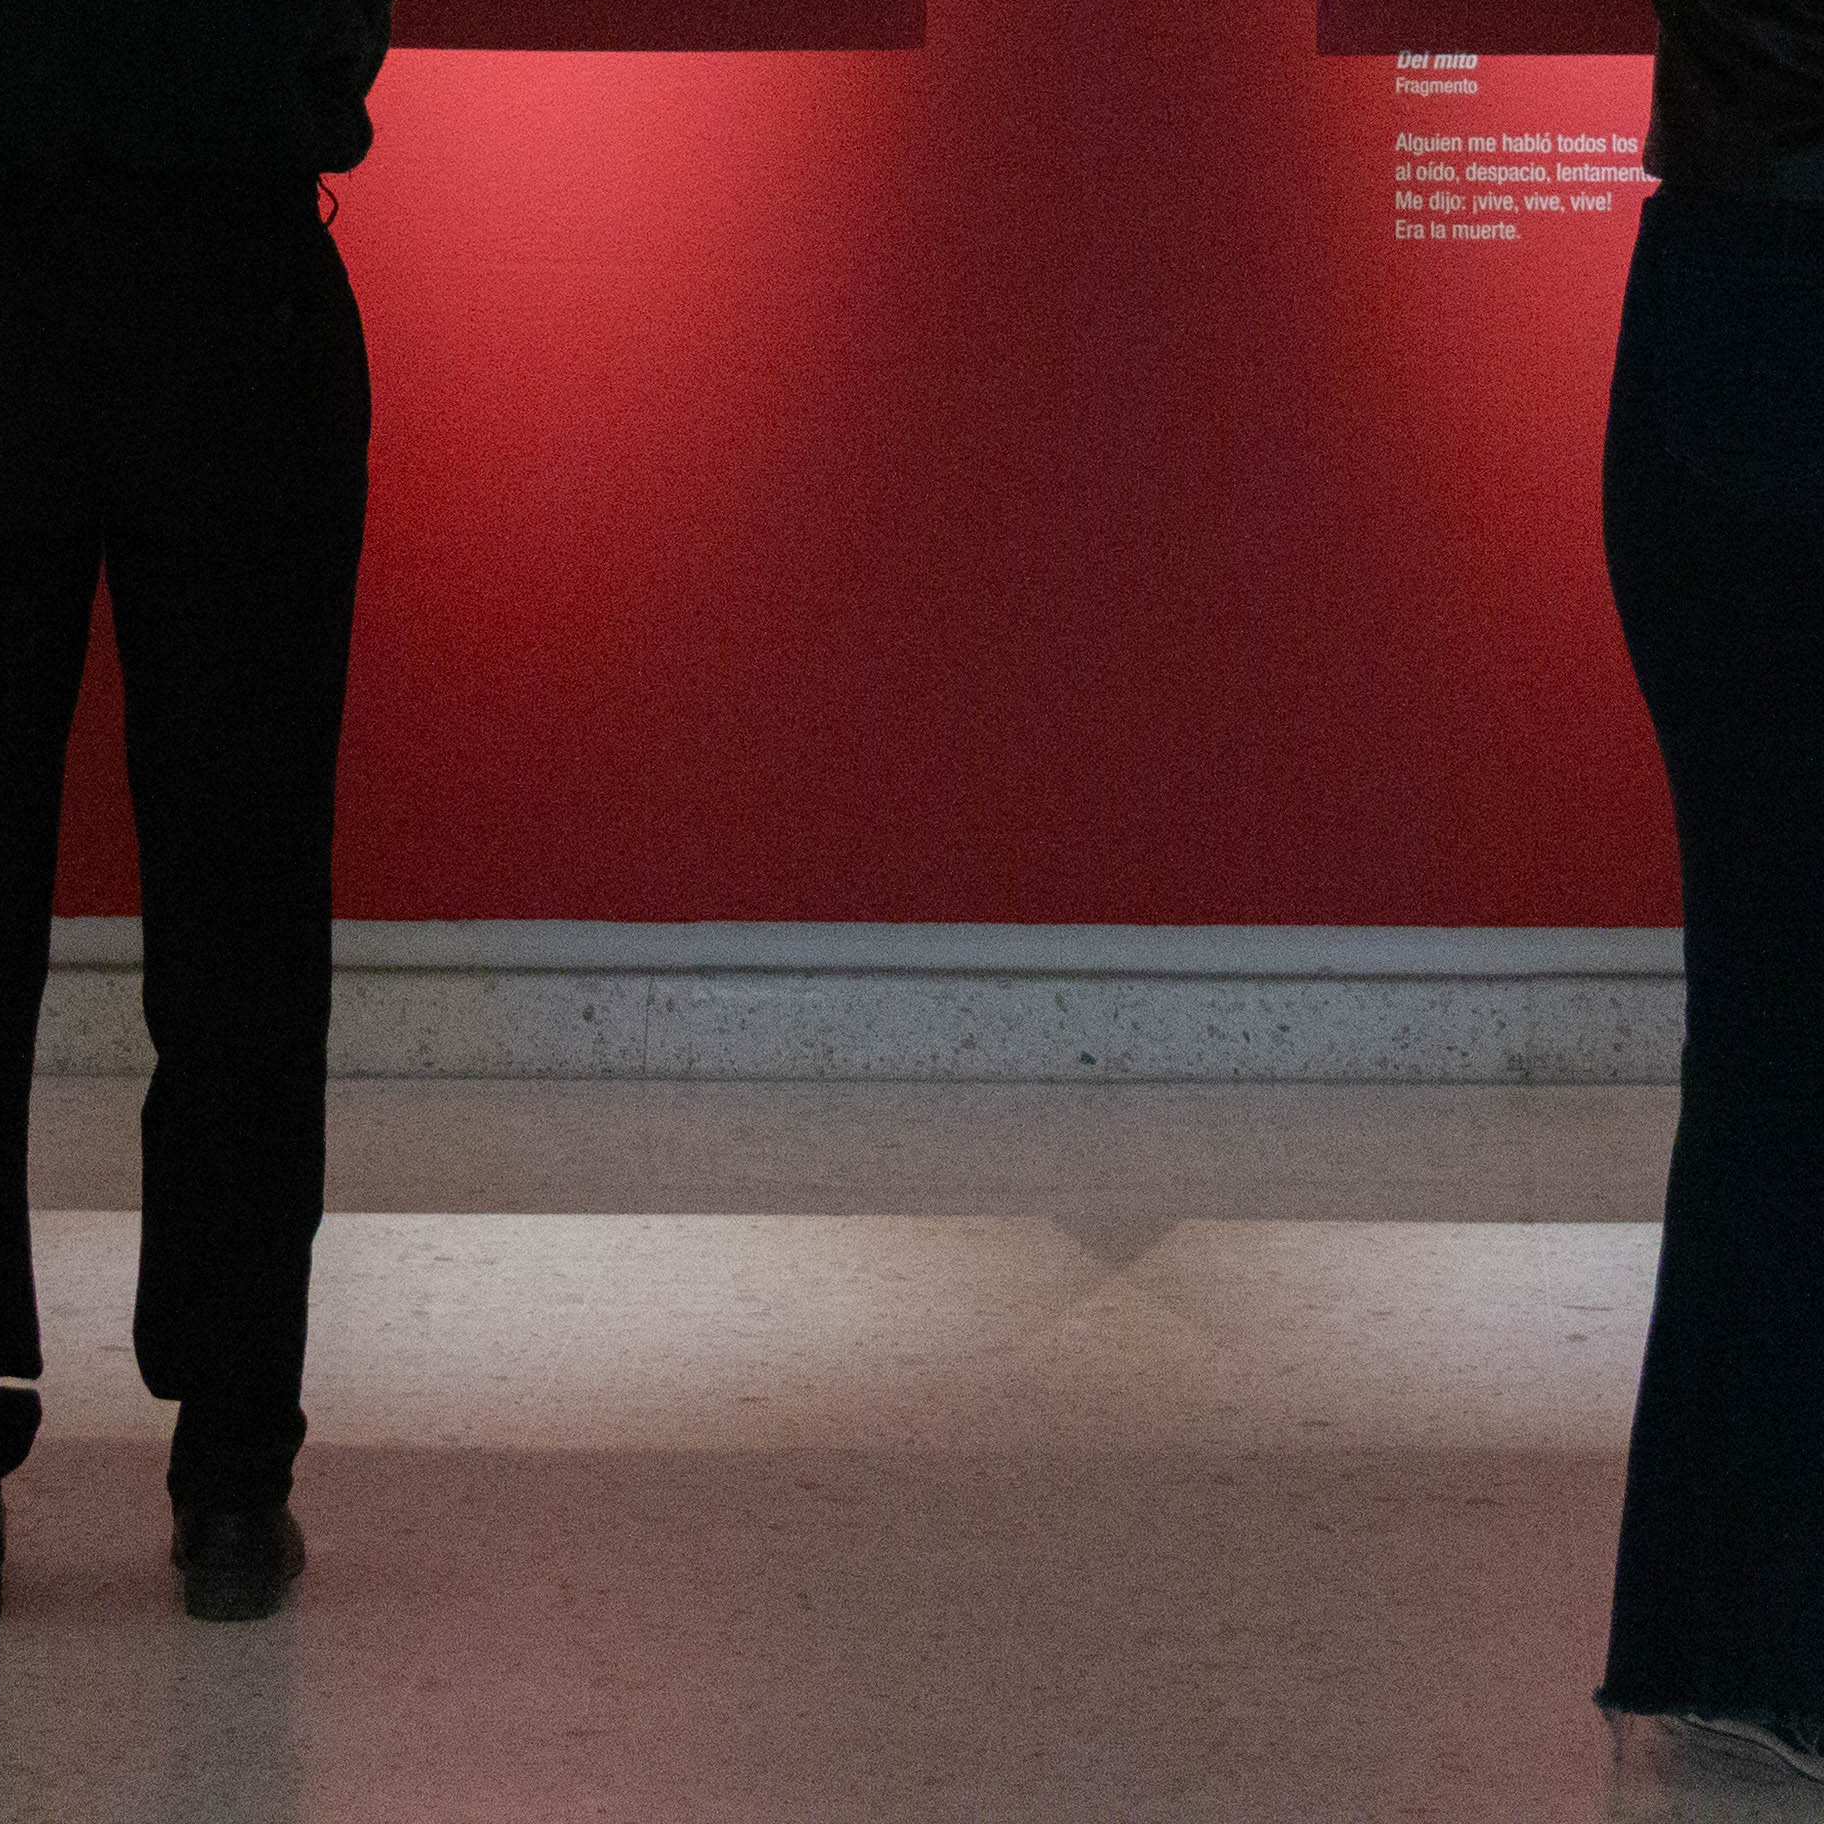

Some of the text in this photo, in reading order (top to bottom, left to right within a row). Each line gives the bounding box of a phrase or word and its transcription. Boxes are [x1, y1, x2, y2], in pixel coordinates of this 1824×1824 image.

[1397, 50, 1478, 69] Del mito
[1395, 77, 1478, 97] Fragmento
[1395, 132, 1638, 155] Alguien me habló todos los
[1395, 162, 1412, 181] al
[1415, 161, 1460, 184] oído,
[1465, 162, 1551, 185] despacio,
[1395, 191, 1613, 215] Me dijo: ¡vive, vive, vive!
[1395, 219, 1521, 240] Era la muerte.
